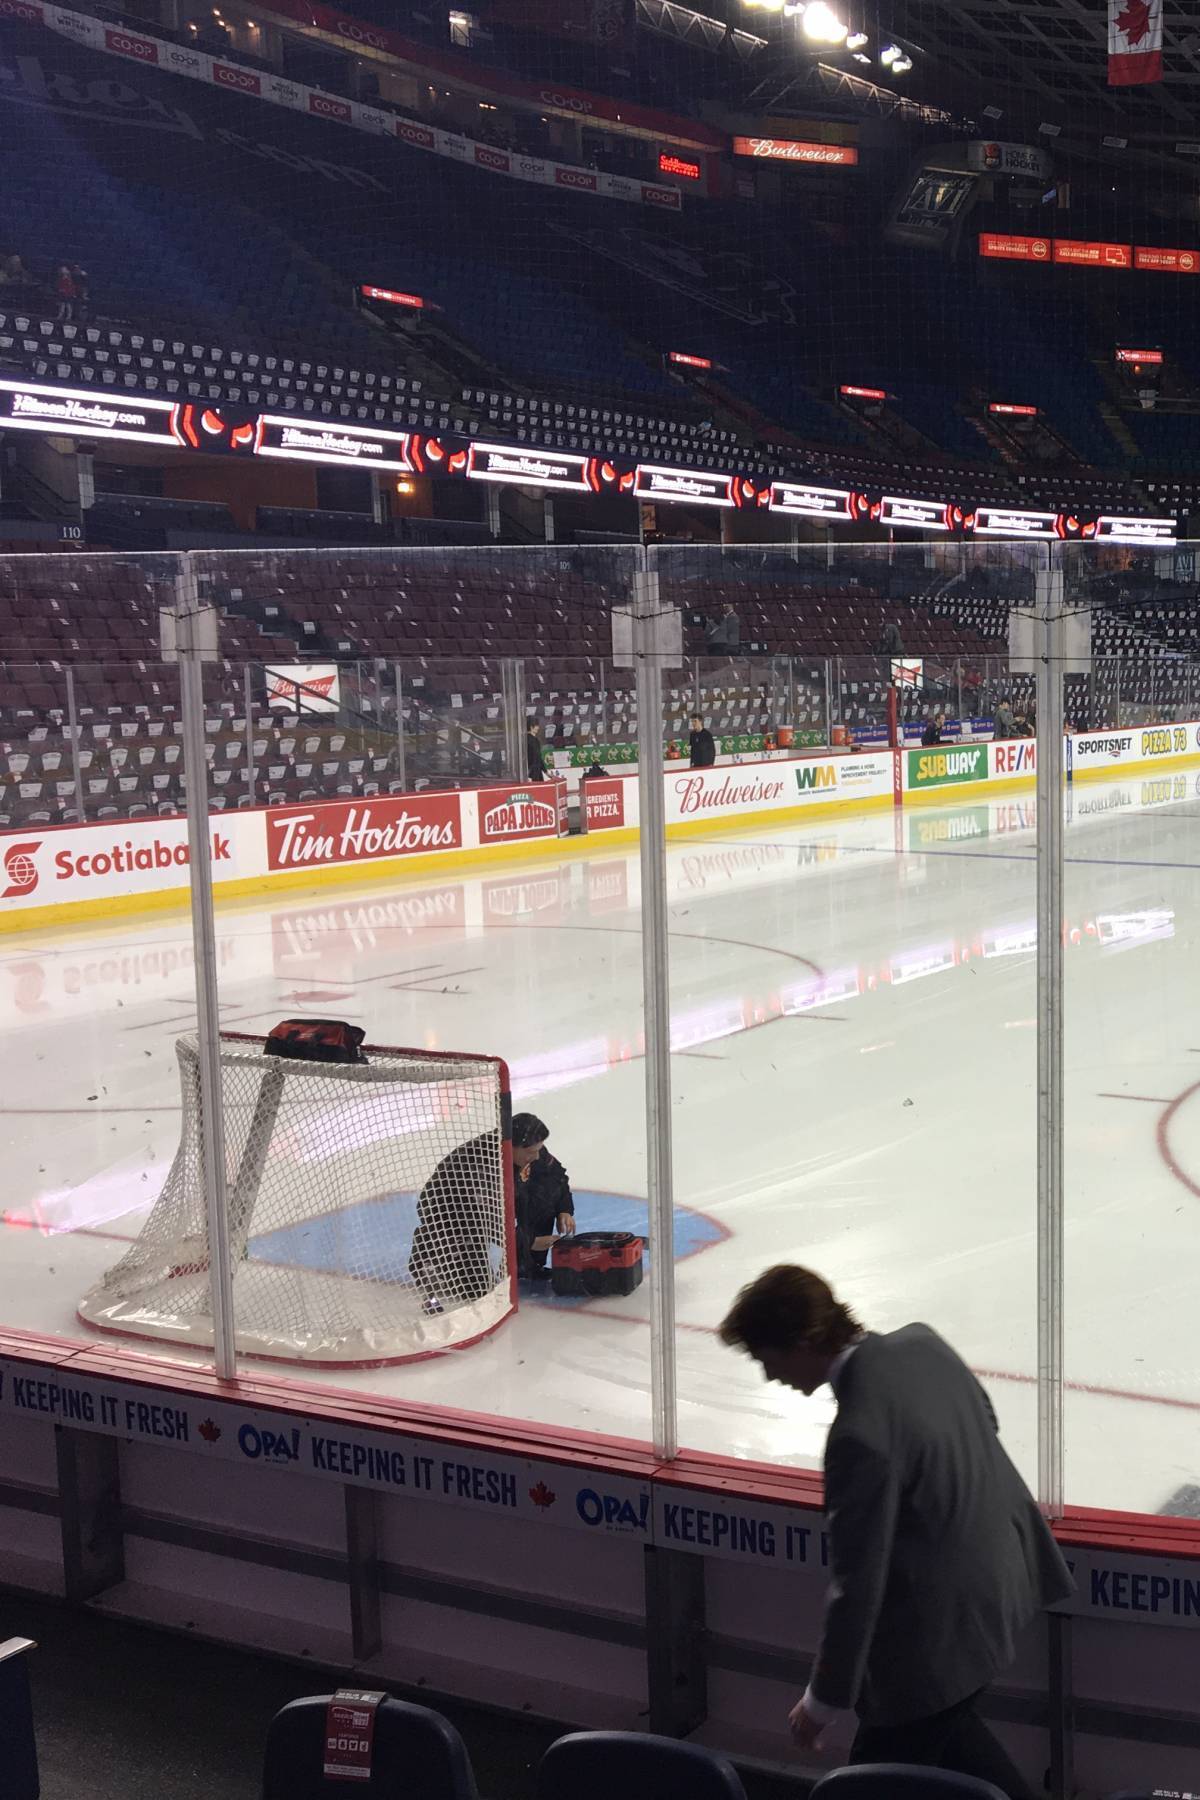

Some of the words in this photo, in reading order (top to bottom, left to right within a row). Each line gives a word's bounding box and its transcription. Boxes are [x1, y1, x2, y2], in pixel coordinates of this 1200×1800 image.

[0, 3, 36, 20] O-OP
[110, 35, 153, 56] CO-OP
[218, 69, 255, 88] CO-OP
[313, 100, 347, 115] CO-OP
[400, 128, 431, 143] CO-OP
[477, 151, 506, 167] CO-OP
[749, 138, 844, 163] Budweiser
[559, 172, 593, 186] CO-OP
[645, 190, 676, 202] CO-OP
[12, 393, 146, 427] HitmenHockey.com
[280, 427, 383, 456] HitmenHockey.com
[487, 453, 568, 478] HitmenHockey.com
[62, 526, 81, 540] 110
[1078, 737, 1132, 755] SPORTSNET
[1142, 730, 1171, 755] PIZZA
[1174, 727, 1187, 750] 73
[917, 750, 981, 780] SUBWAY
[996, 744, 1035, 773] RE/M
[795, 765, 837, 789] WM
[587, 793, 619, 804] GREDIENTS.
[675, 776, 784, 814] Budweiser
[487, 812, 517, 833] PAPA
[594, 804, 619, 818] PIZZA.
[273, 814, 334, 864] Tim
[339, 808, 453, 856] Hortons
[13, 1377, 95, 1424] KEEPING
[98, 1396, 118, 1427] IT
[126, 1400, 190, 1441] FRESH
[238, 1421, 299, 1461] OPA!
[311, 1436, 406, 1486] KEEPING
[414, 1457, 436, 1491] IT
[442, 1461, 518, 1507] FRESH
[576, 1487, 650, 1531] OPA!
[663, 1504, 776, 1557] KEEPING
[785, 1526, 812, 1562] IT
